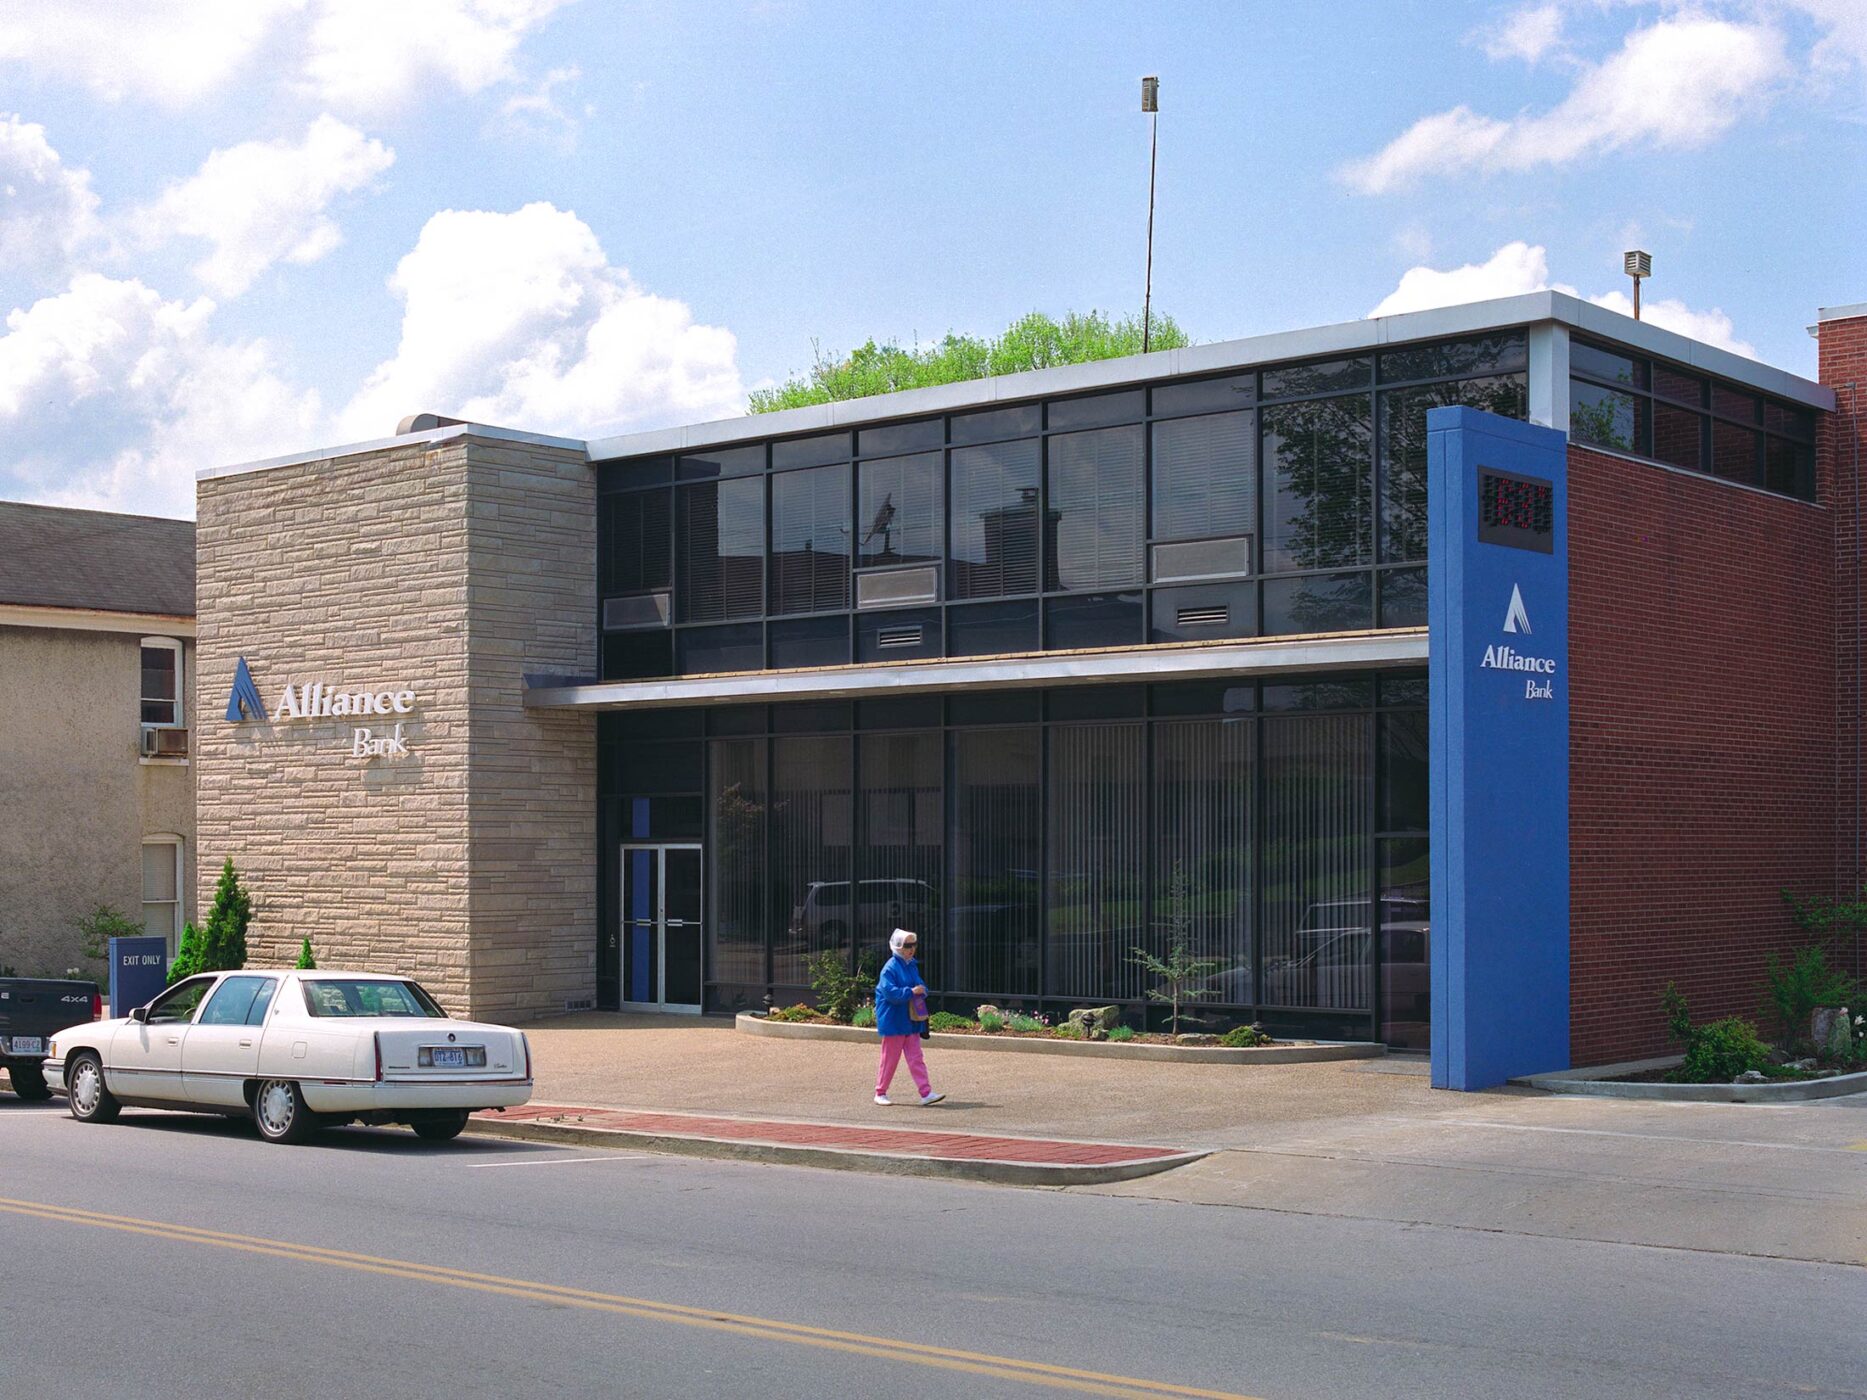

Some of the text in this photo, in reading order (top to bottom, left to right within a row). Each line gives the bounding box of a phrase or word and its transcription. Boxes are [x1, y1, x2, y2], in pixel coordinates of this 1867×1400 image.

[1480, 644, 1556, 674] Alliance
[274, 681, 417, 719] Alliance
[1525, 680, 1553, 699] Bank
[352, 723, 409, 758] Bank
[123, 955, 161, 966] EXIT ONLY
